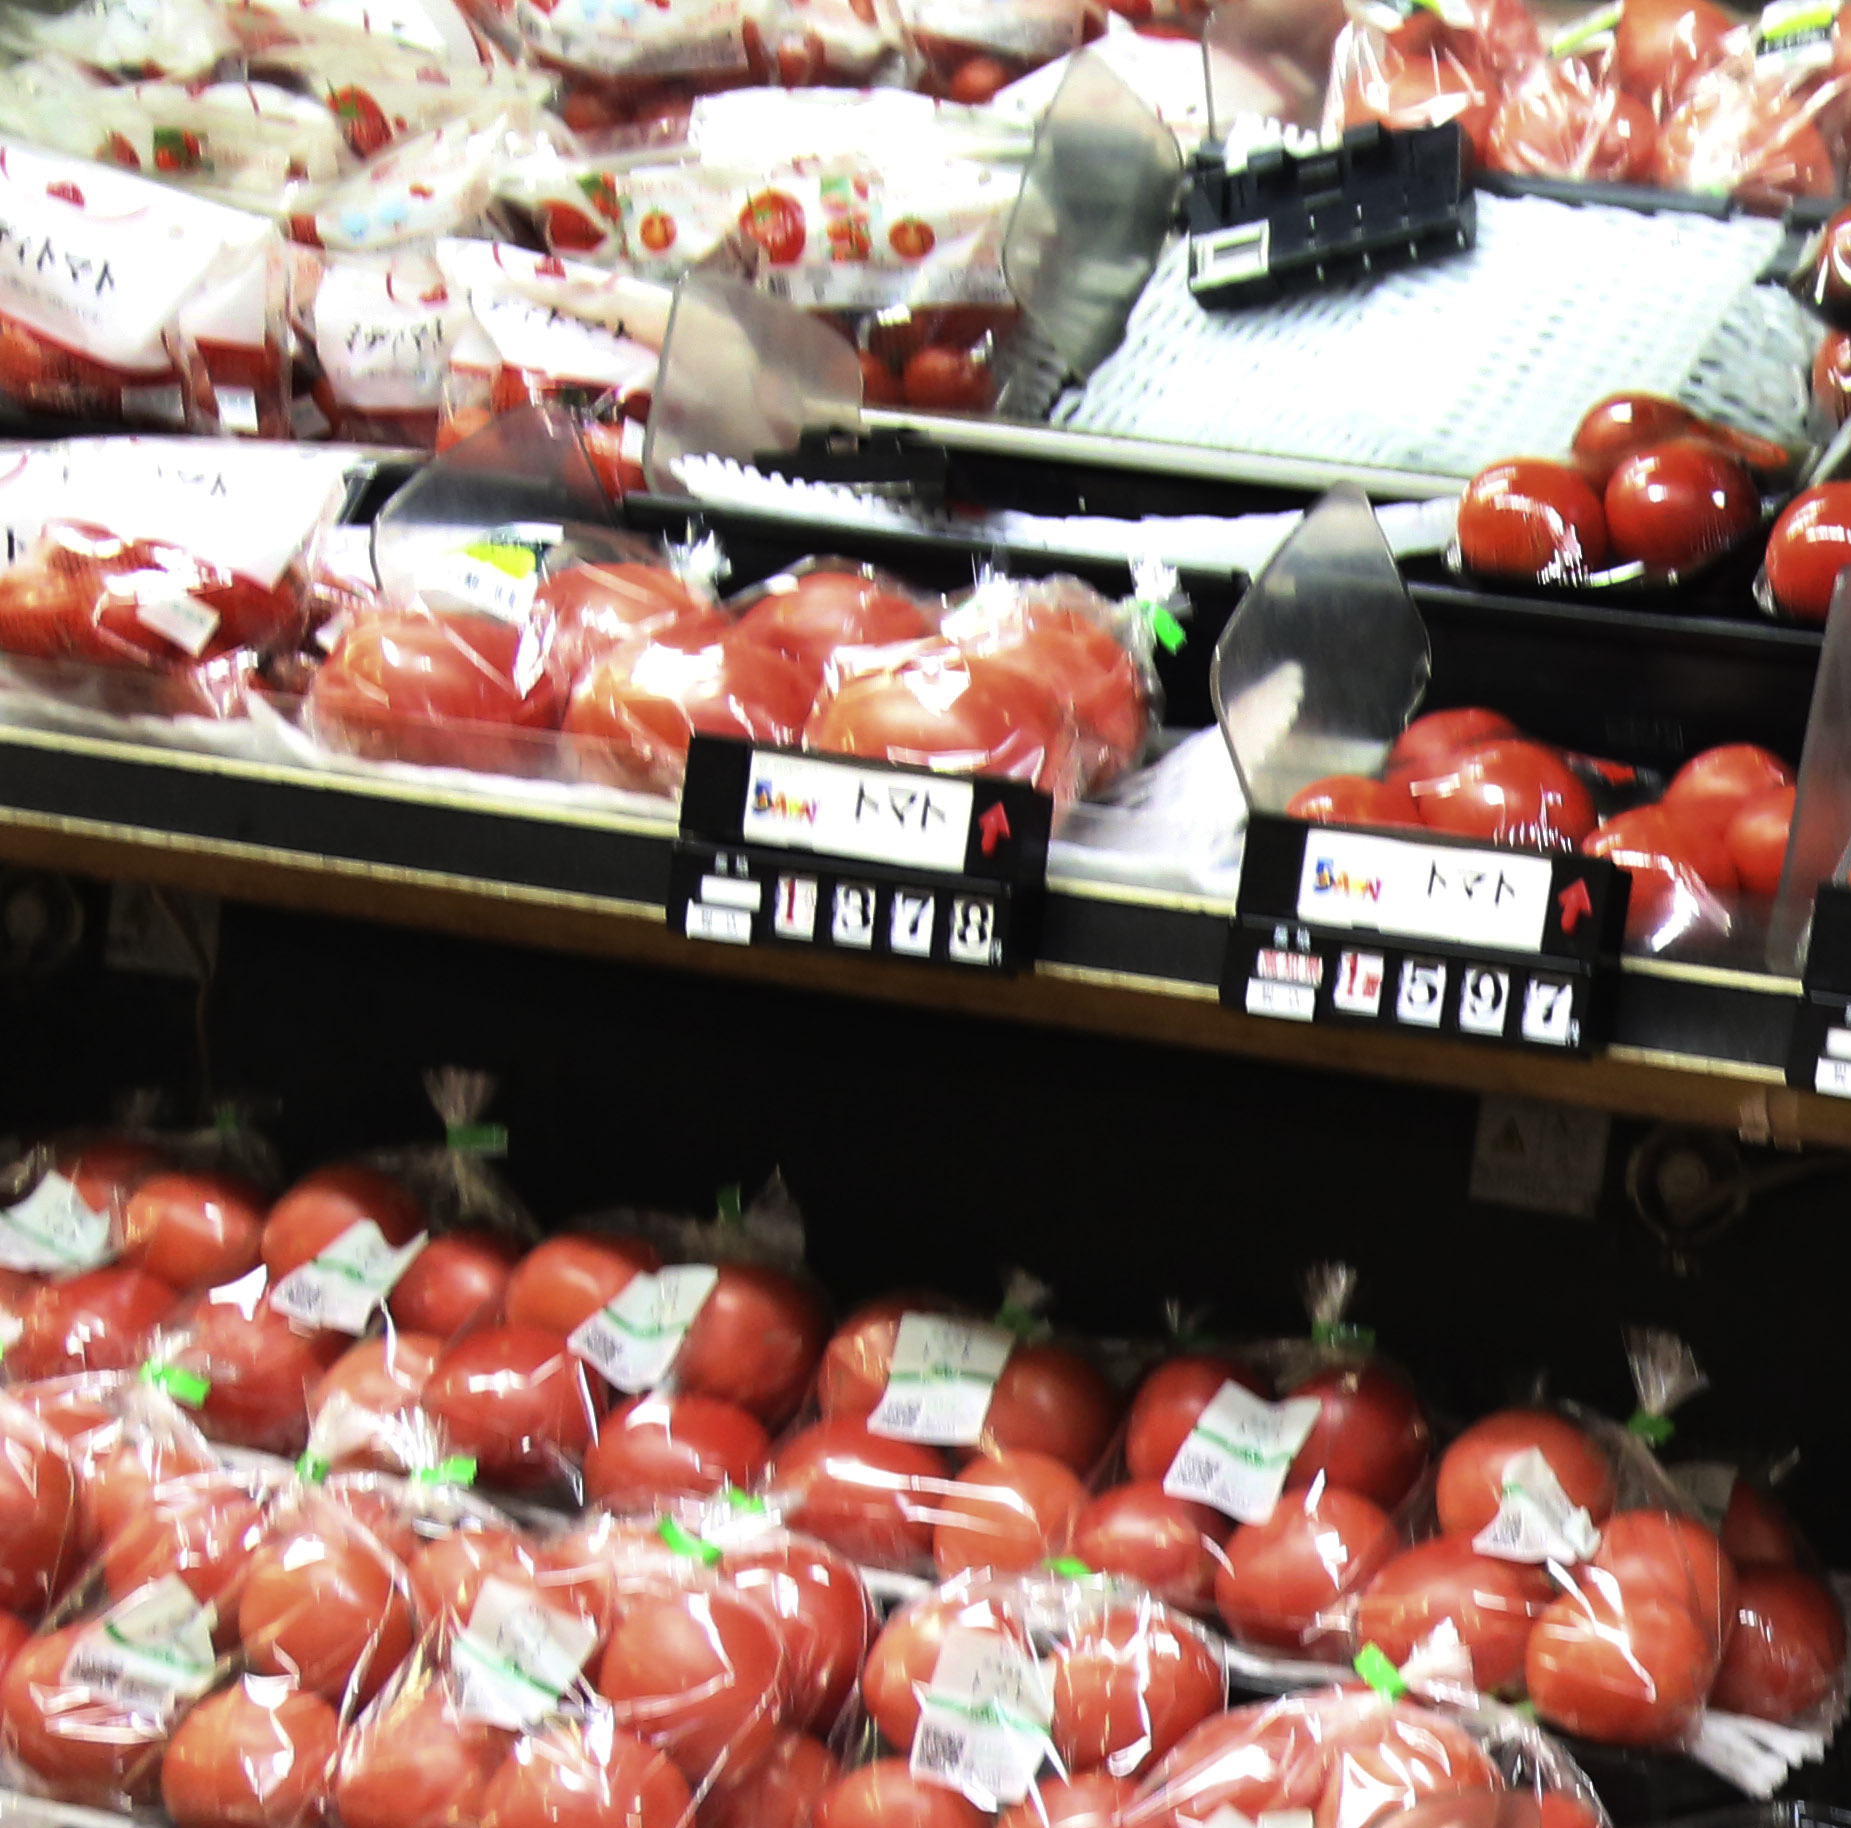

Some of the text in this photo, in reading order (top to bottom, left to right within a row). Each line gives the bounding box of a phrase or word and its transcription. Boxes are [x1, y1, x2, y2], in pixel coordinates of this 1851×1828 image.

[855, 779, 948, 834] トマト
[1427, 859, 1516, 908] トマト
[1410, 963, 1573, 1027] 597
